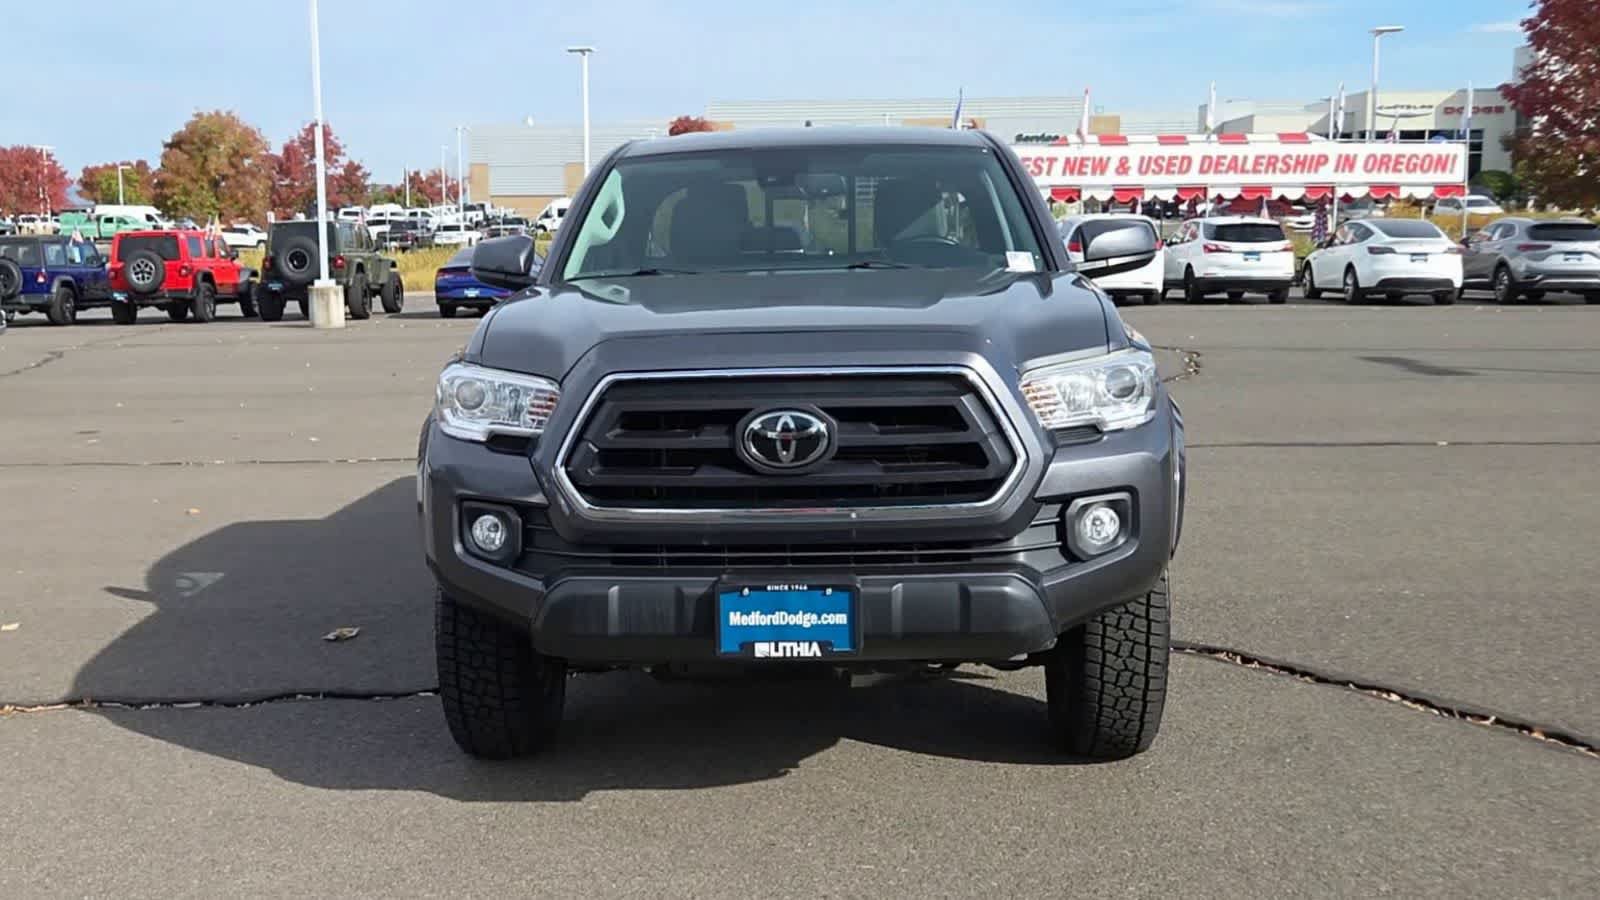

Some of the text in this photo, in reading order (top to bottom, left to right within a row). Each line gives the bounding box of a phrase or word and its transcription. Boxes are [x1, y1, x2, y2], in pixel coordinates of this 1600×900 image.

[1015, 132, 1060, 143] Service
[1062, 156, 1111, 176] NEW
[1115, 156, 1131, 176] &
[1138, 155, 1193, 176] USED
[1199, 154, 1329, 175] DEALERSHIP
[1334, 154, 1358, 173] IN
[1363, 153, 1458, 174] OREGON!
[729, 611, 848, 628] MedfordDodge.com
[769, 641, 822, 657] LITHIA
